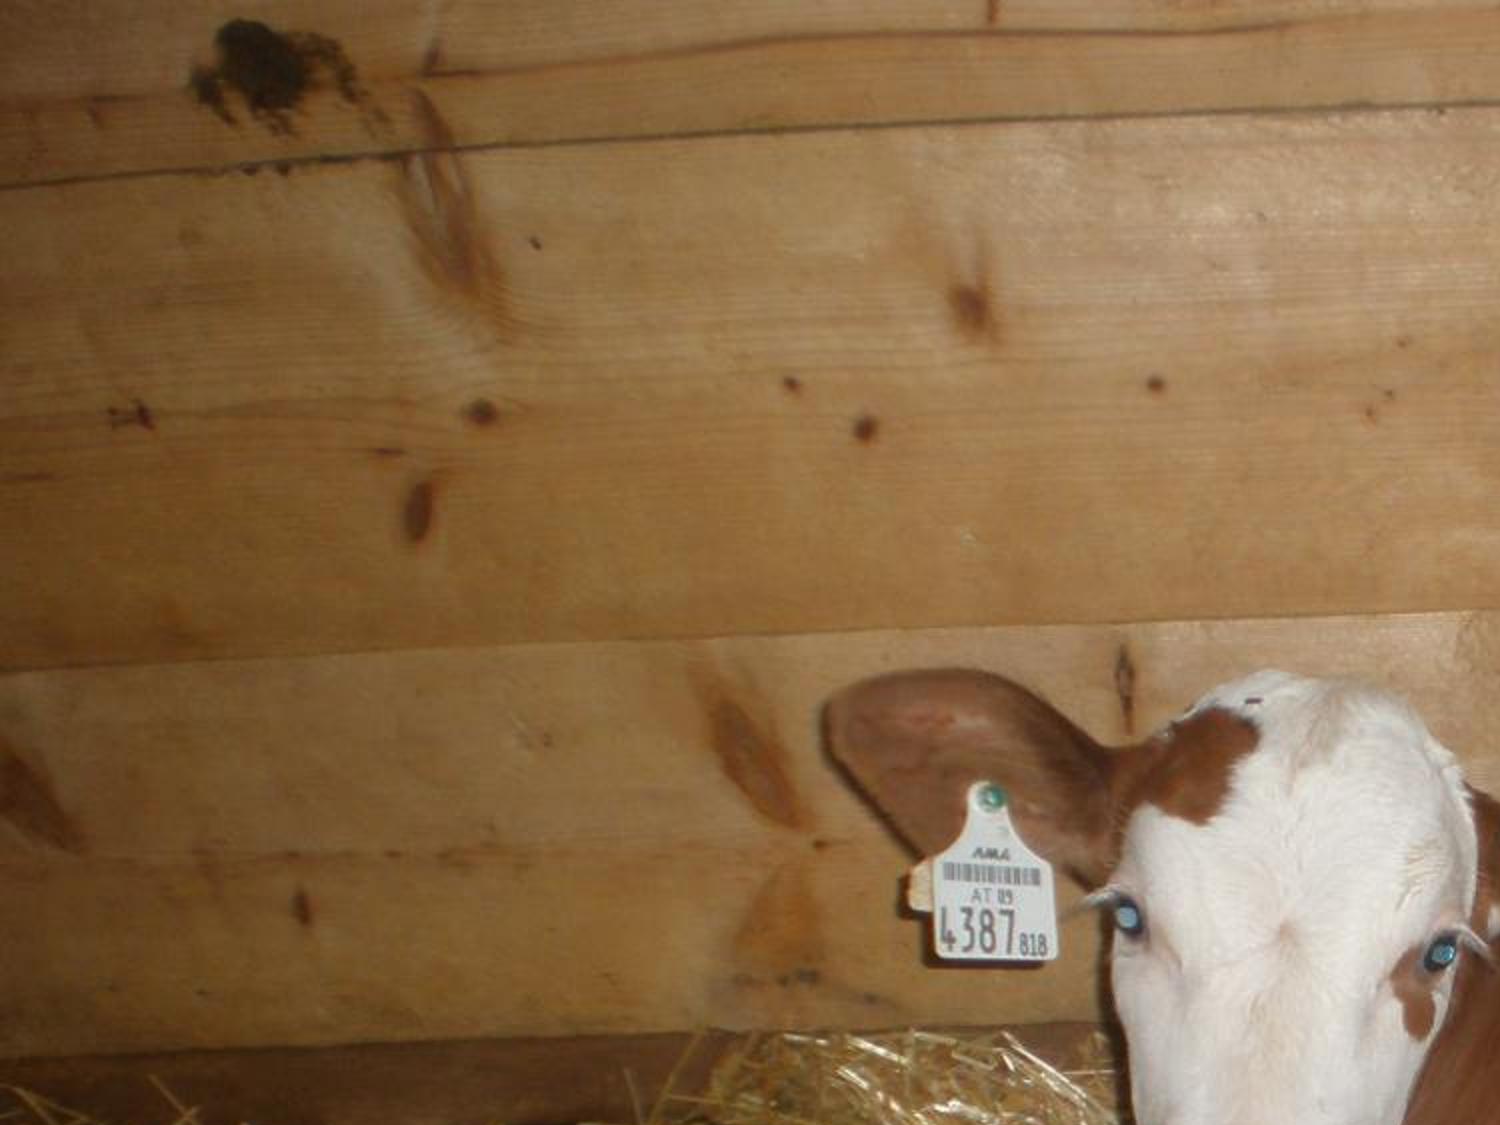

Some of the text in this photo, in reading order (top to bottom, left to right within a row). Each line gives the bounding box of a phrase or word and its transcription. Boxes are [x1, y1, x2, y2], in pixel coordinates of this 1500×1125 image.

[971, 887, 993, 904] AT
[940, 906, 1048, 957] 4387 818
